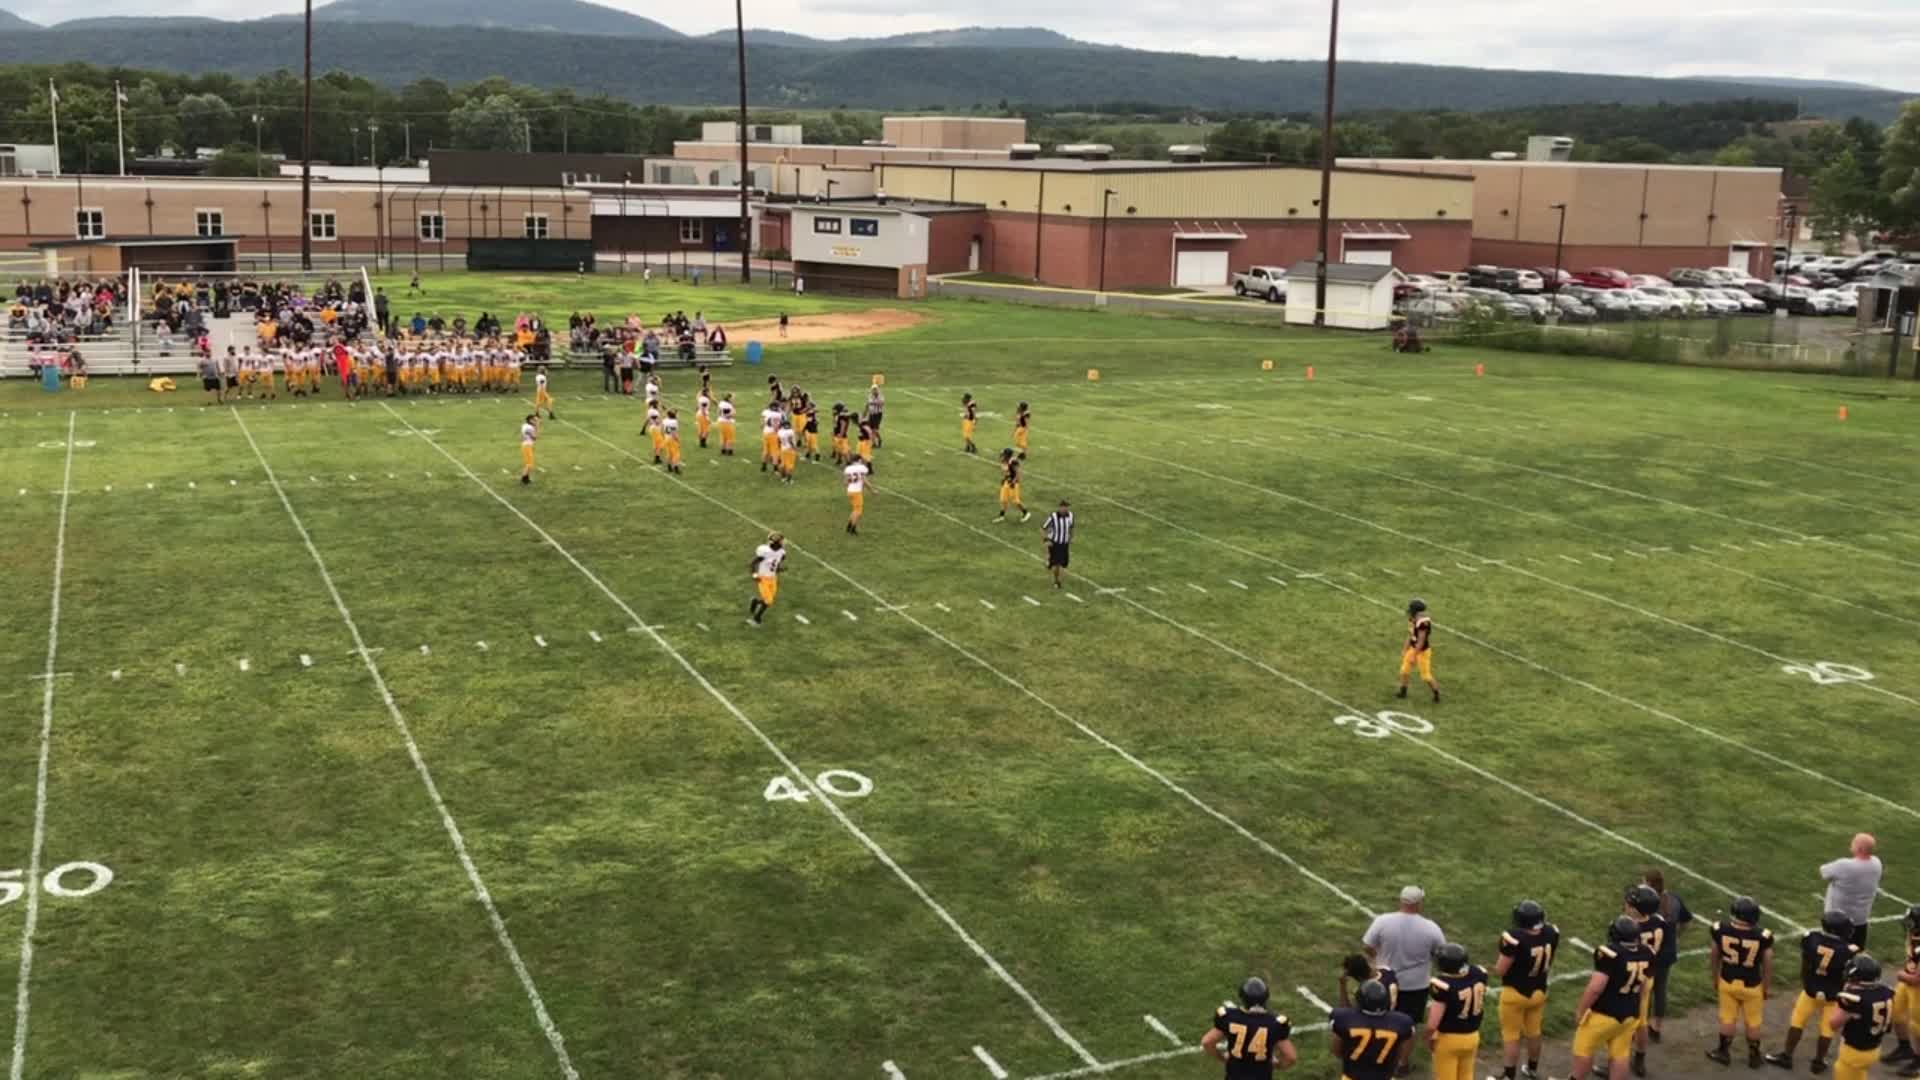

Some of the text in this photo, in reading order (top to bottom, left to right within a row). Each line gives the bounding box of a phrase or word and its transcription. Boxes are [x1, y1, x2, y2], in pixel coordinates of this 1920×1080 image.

[1782, 661, 1874, 684] 20
[1334, 710, 1434, 738] 30
[763, 769, 873, 802] 40
[1721, 935, 1760, 967] 57
[1816, 944, 1834, 976] 7
[1620, 960, 1649, 994] 75
[1229, 1022, 1268, 1061] 74
[1350, 1028, 1398, 1064] 77
